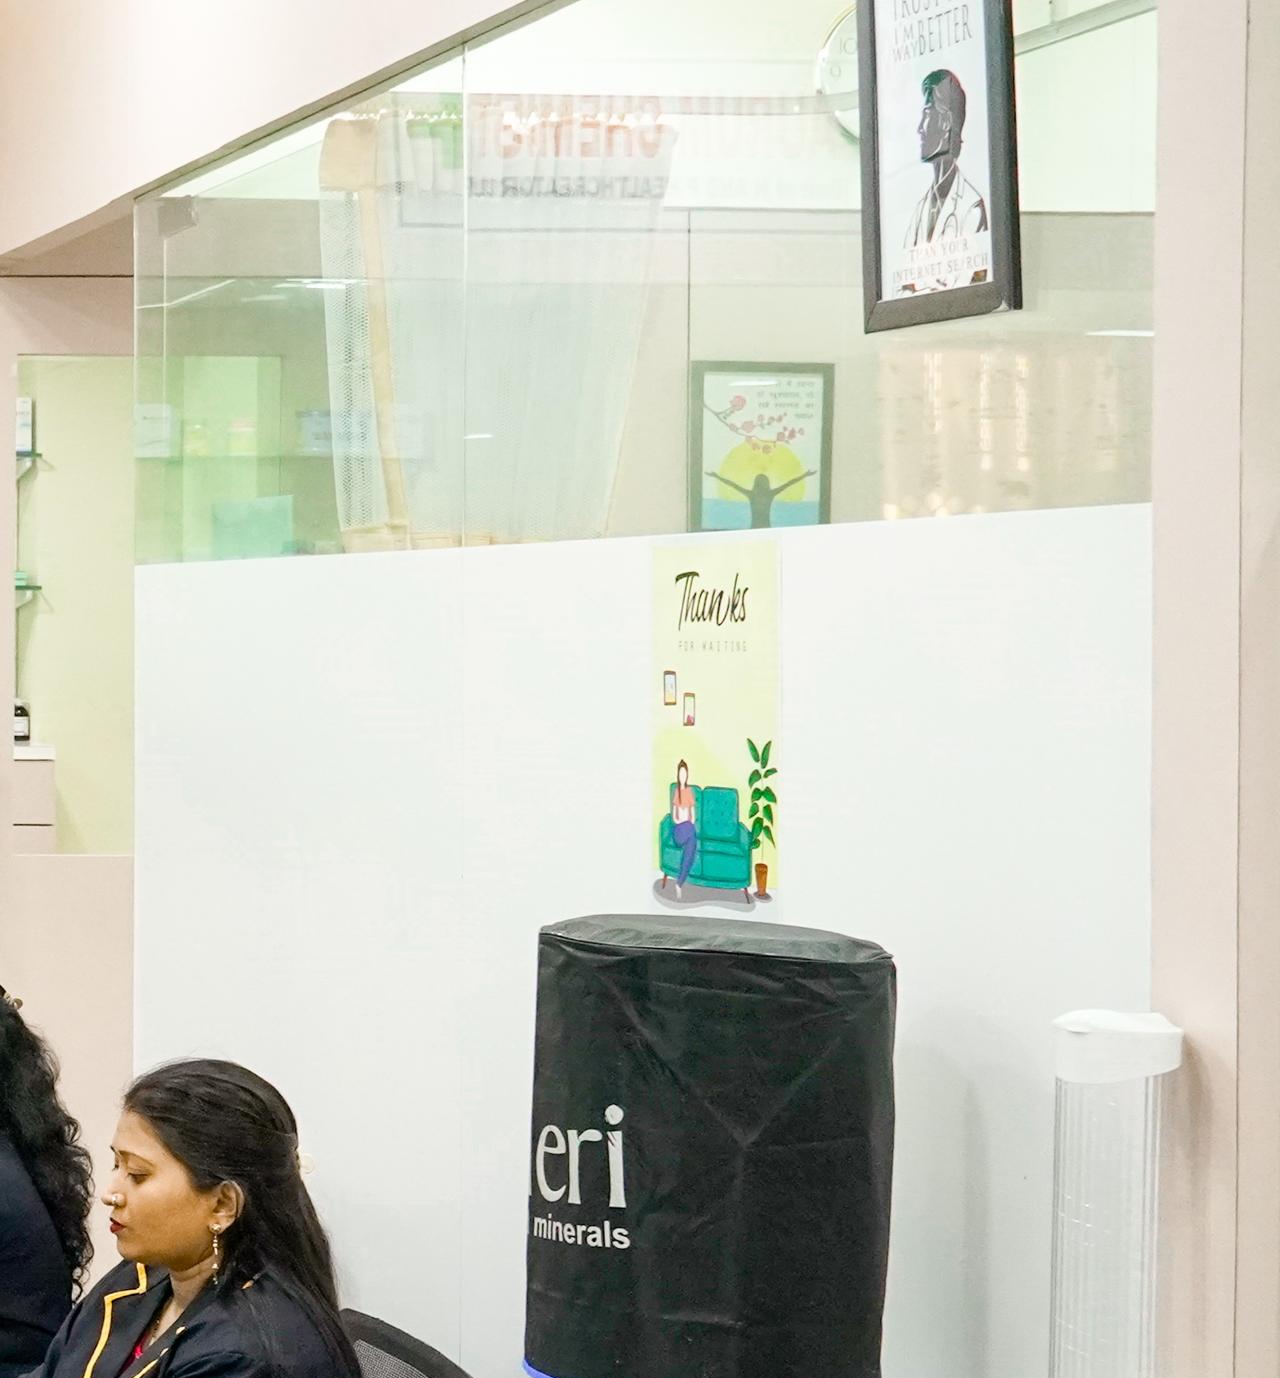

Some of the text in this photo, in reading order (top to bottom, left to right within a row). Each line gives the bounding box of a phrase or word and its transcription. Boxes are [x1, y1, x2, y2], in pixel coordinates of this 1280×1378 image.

[917, 4, 973, 56] BETTER
[675, 571, 749, 631] Thanks
[678, 640, 748, 652] FOR WAITING
[534, 1213, 631, 1250] minerals
